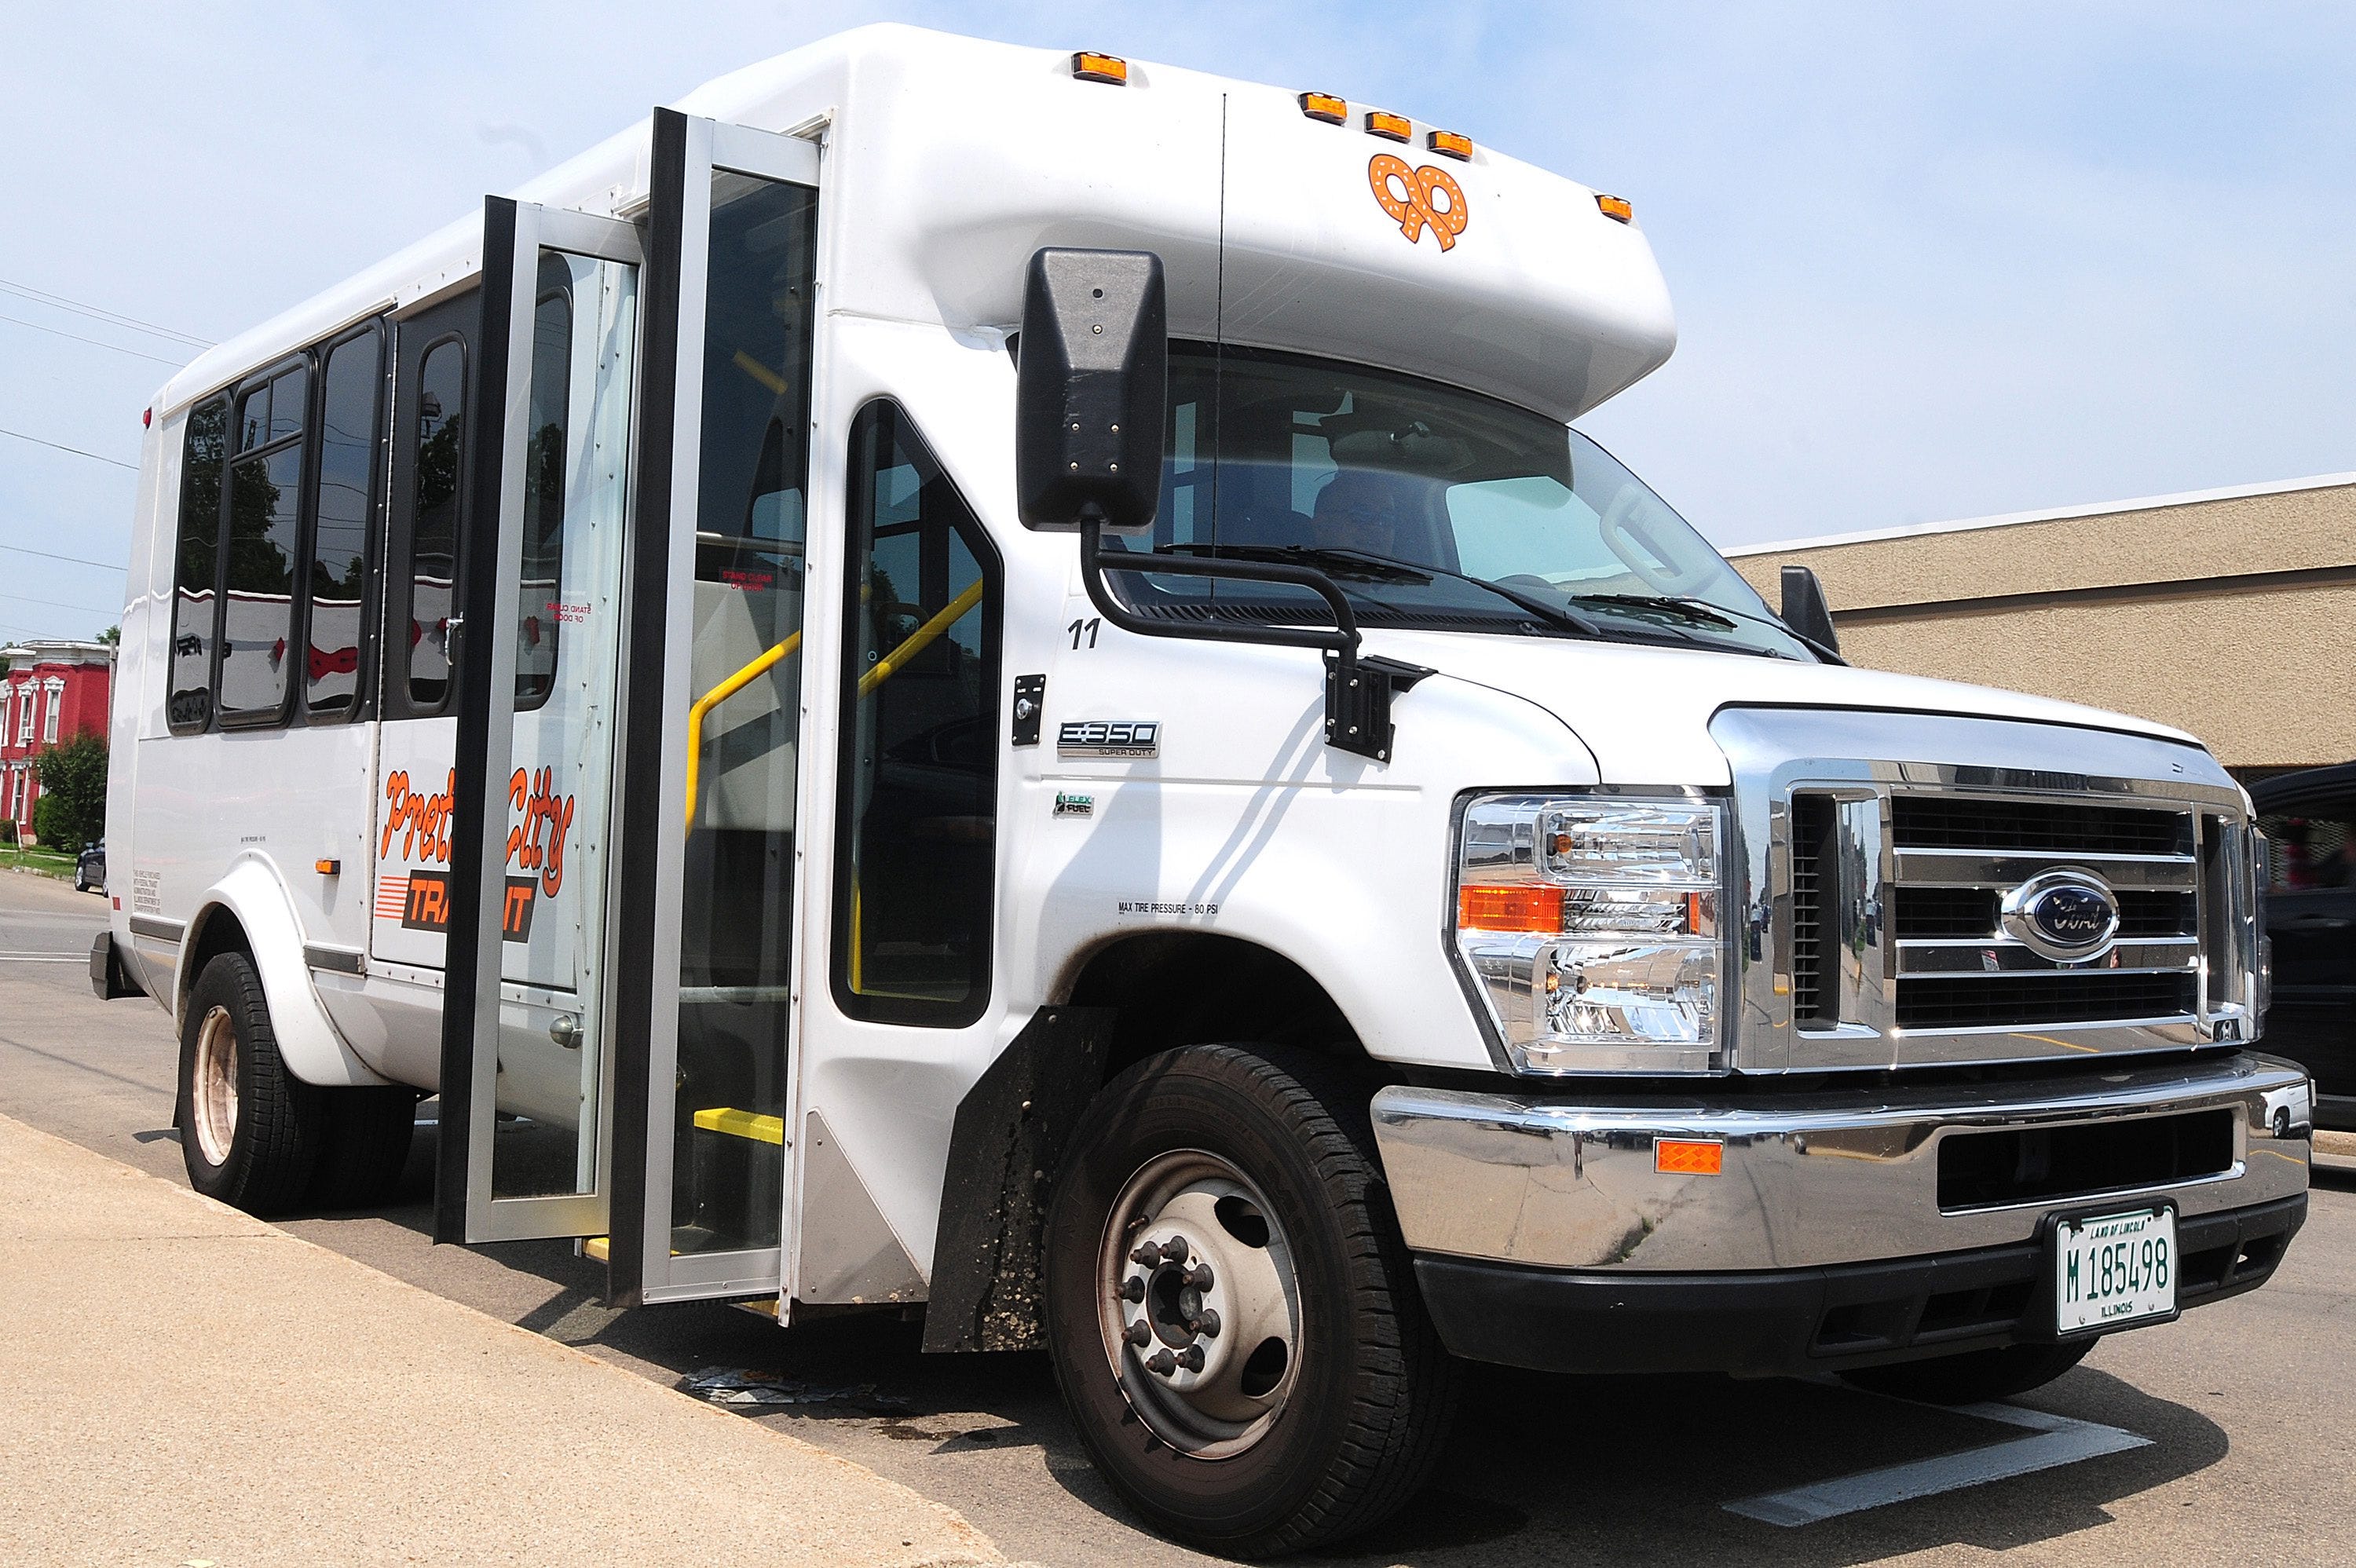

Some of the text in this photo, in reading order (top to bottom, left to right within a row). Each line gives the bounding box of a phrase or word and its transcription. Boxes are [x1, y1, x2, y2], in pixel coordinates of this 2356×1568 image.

[1067, 618, 1101, 650] 11
[1066, 804, 1092, 813] FUEL
[1067, 795, 1092, 804] FLEX
[1118, 902, 1133, 912] MAX
[1135, 902, 1149, 912] TIRE
[1151, 903, 1187, 914] PRESSURE
[1194, 904, 1205, 914] 80
[1206, 904, 1219, 915] PSI
[2051, 896, 2102, 931] Ford
[2090, 1220, 2146, 1240] LAND OF LINCOLN
[2066, 1237, 2168, 1303] M 185498
[2101, 1300, 2133, 1318] ILLINOIS
